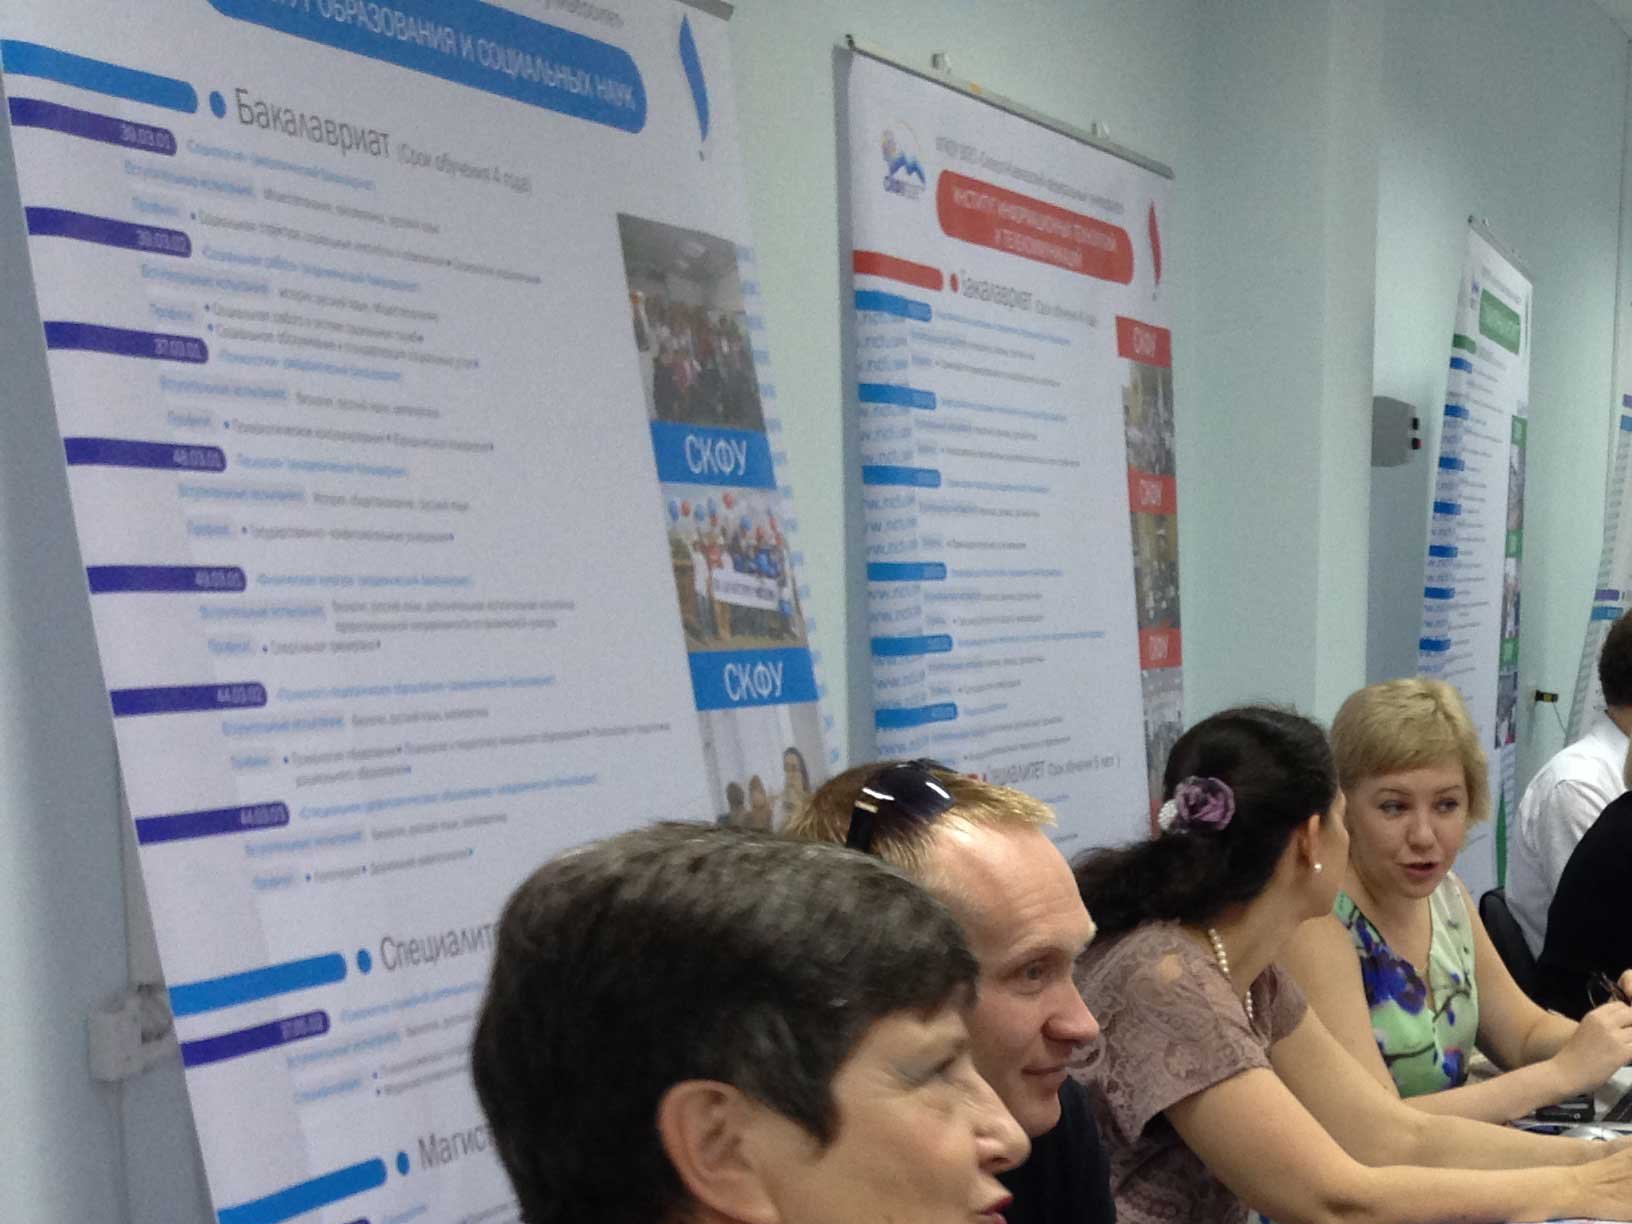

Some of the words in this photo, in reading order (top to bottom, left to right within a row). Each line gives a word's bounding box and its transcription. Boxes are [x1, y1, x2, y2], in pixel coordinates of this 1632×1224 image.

[318, 0, 457, 56] ОБРАЗОВАНИЯ
[459, 31, 475, 63] И
[477, 38, 595, 97] СОЦИАЛЬНЫХ
[235, 88, 391, 159] Бакалавриат
[684, 434, 748, 476] СКФУ
[722, 661, 784, 701] СКФУ
